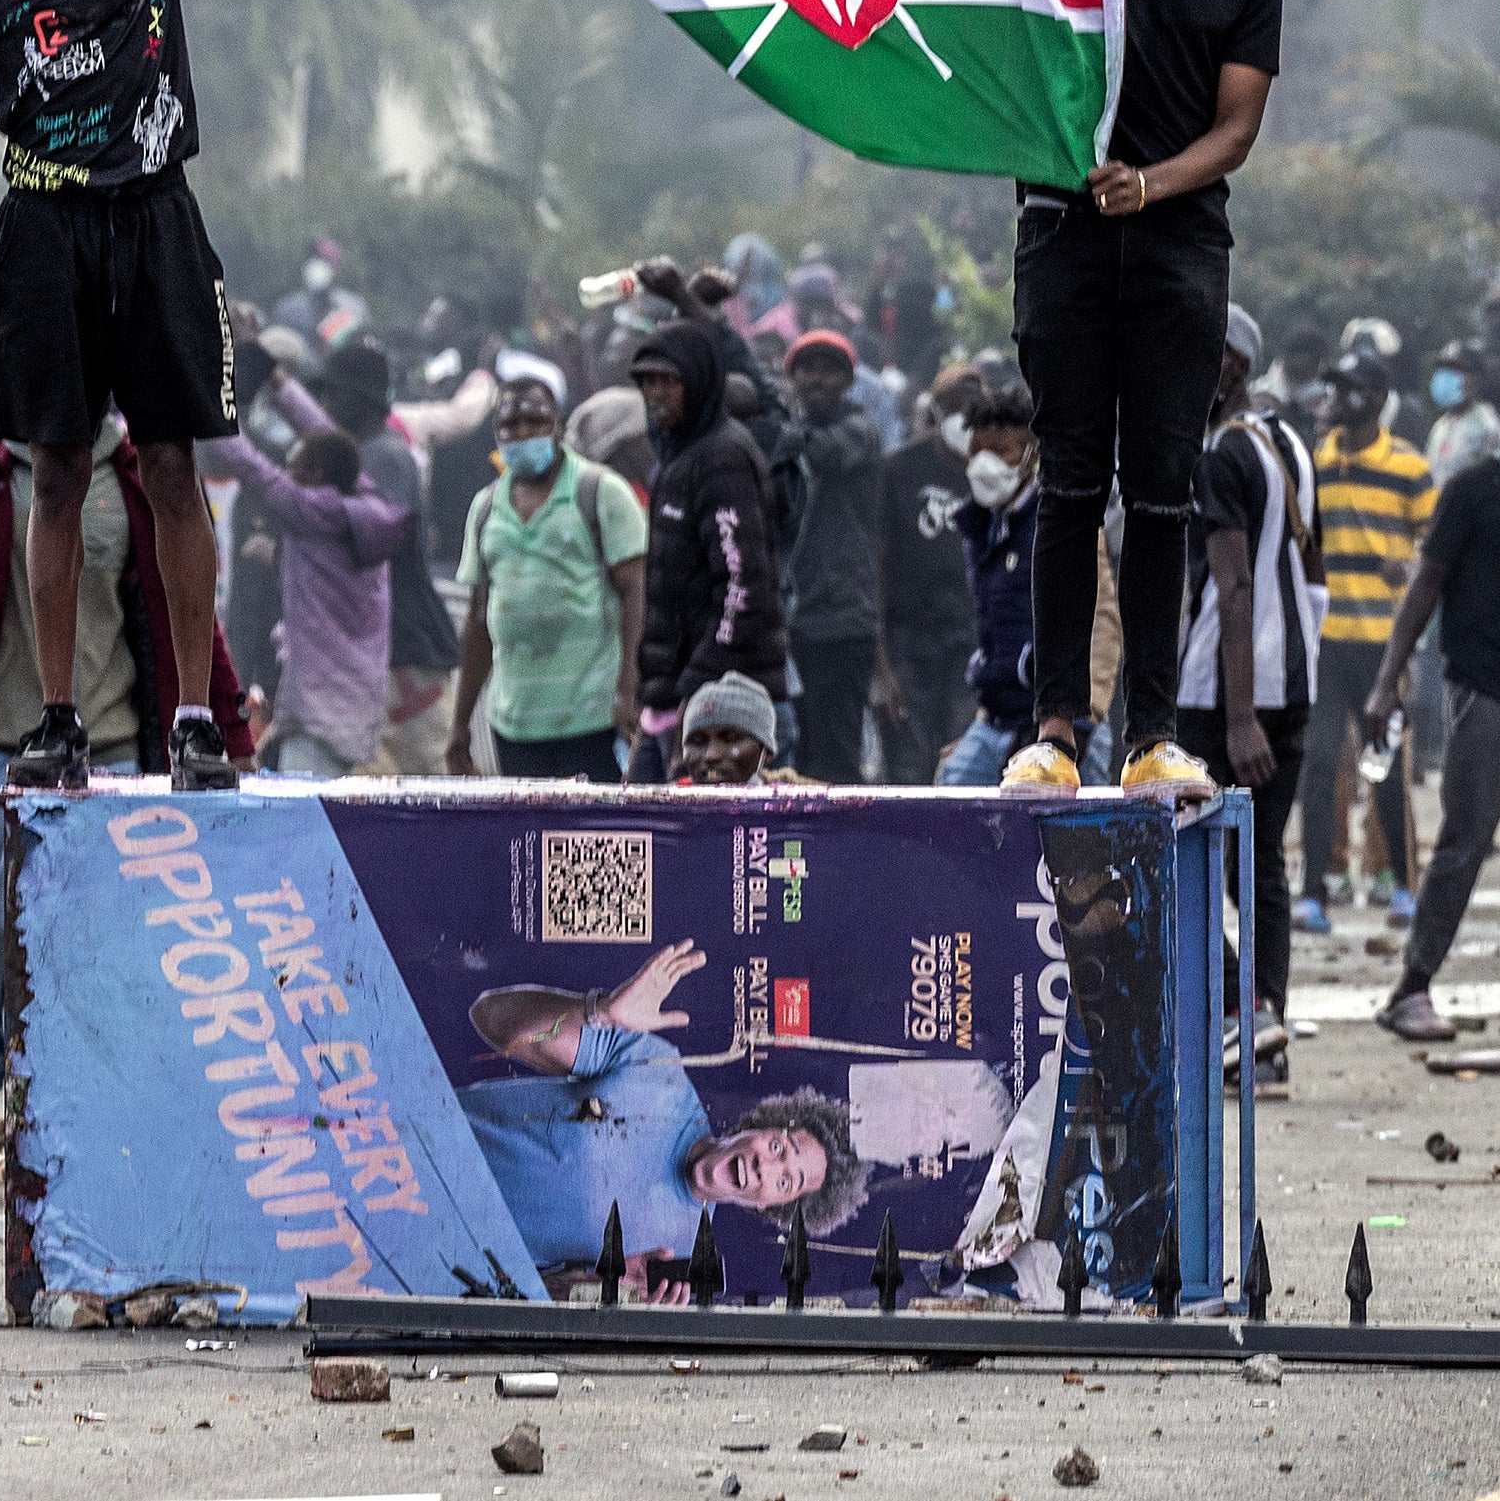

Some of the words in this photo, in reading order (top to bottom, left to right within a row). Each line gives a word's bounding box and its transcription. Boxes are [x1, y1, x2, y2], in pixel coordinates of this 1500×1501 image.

[749, 826, 767, 875] PAY
[749, 957, 767, 1004] PAY
[939, 934, 952, 972] SMS
[955, 933, 972, 991] PLAY
[910, 935, 937, 1041] 79079
[939, 972, 952, 1022] GAME
[108, 804, 385, 1296] OPPORTUNITY
[235, 877, 349, 1023] TAKE
[303, 1042, 429, 1215] EVERY
[955, 993, 972, 1051] NOW
